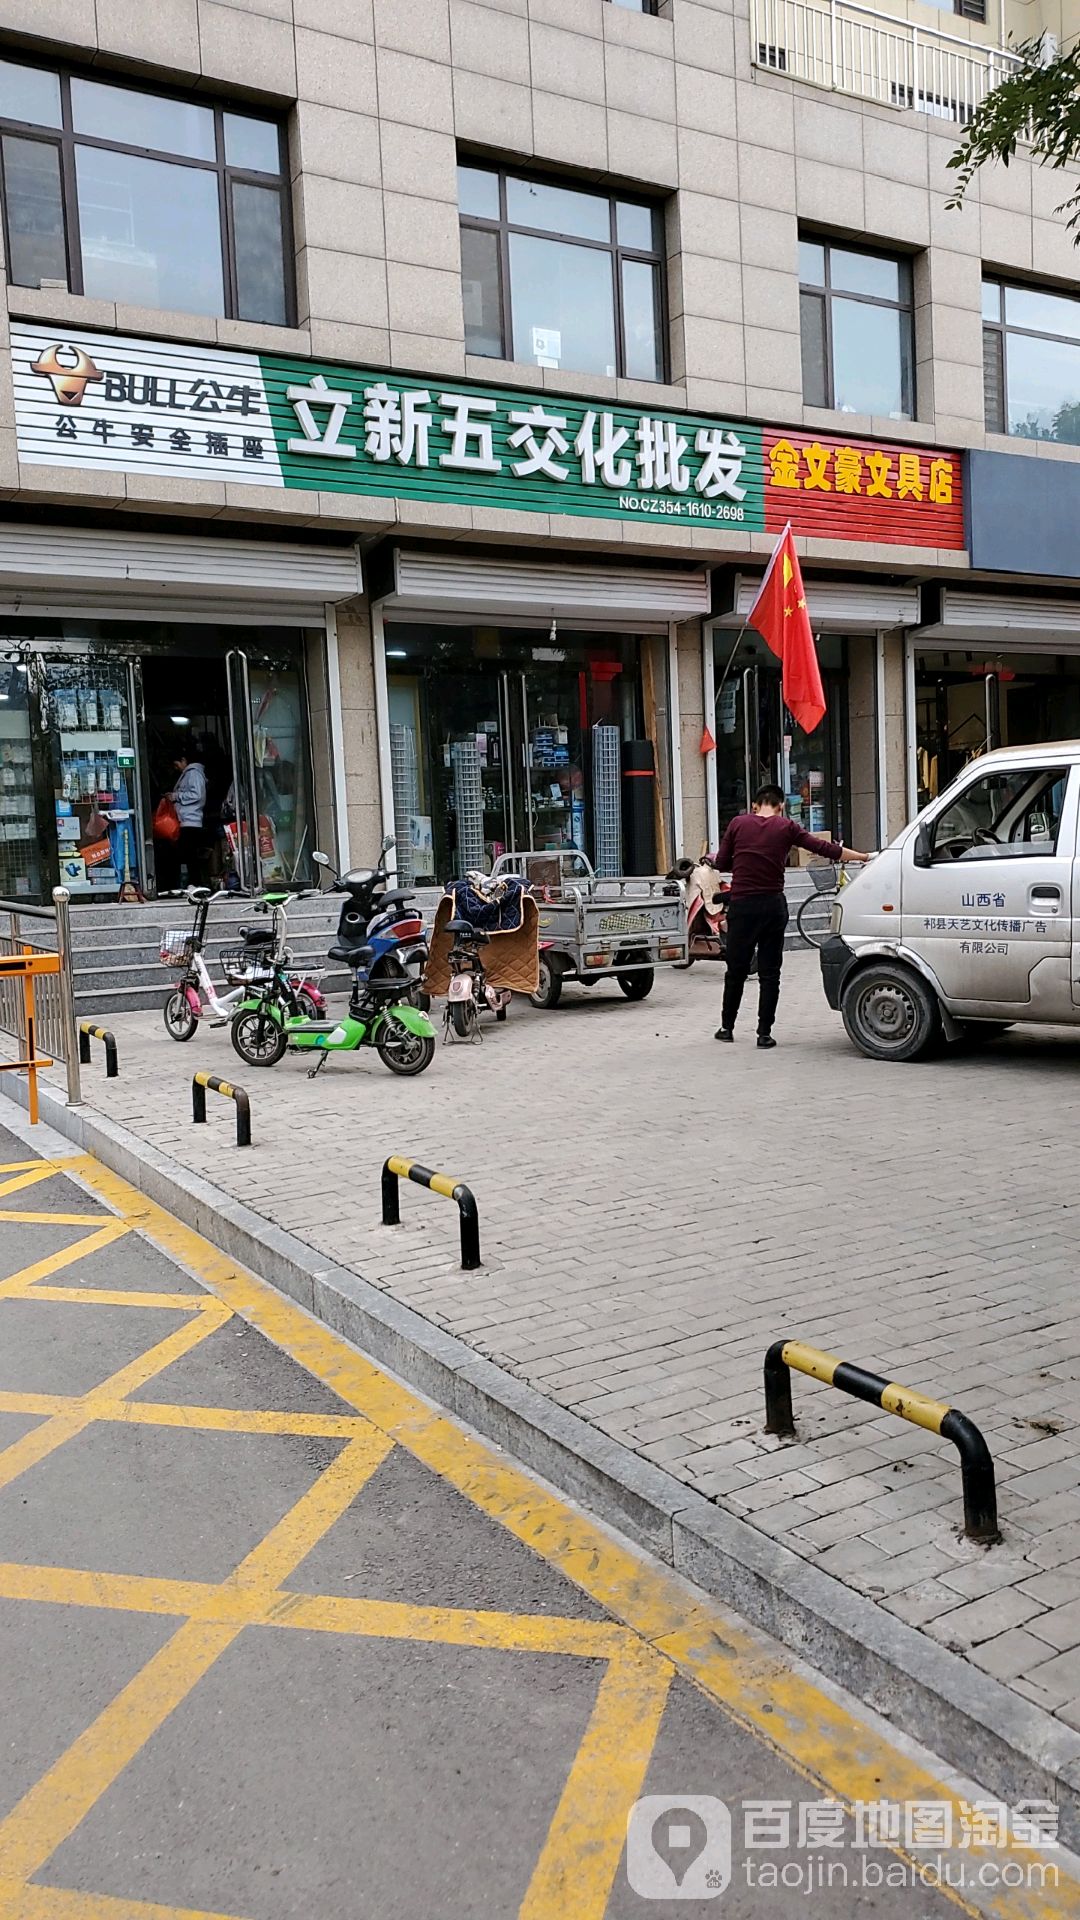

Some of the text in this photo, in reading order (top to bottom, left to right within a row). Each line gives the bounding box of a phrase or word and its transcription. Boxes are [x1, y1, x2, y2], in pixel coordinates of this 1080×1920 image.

[55, 414, 264, 460] 公牛安全插座
[286, 374, 748, 502] 立新五交化批发
[769, 438, 953, 504] 金文豪文具店
[619, 496, 744, 521] NO.CZ354-1610-2698
[962, 892, 1006, 908] 山西省
[923, 917, 1048, 933] 祁县天艺文化传播广告
[959, 941, 1009, 955] 有限公司
